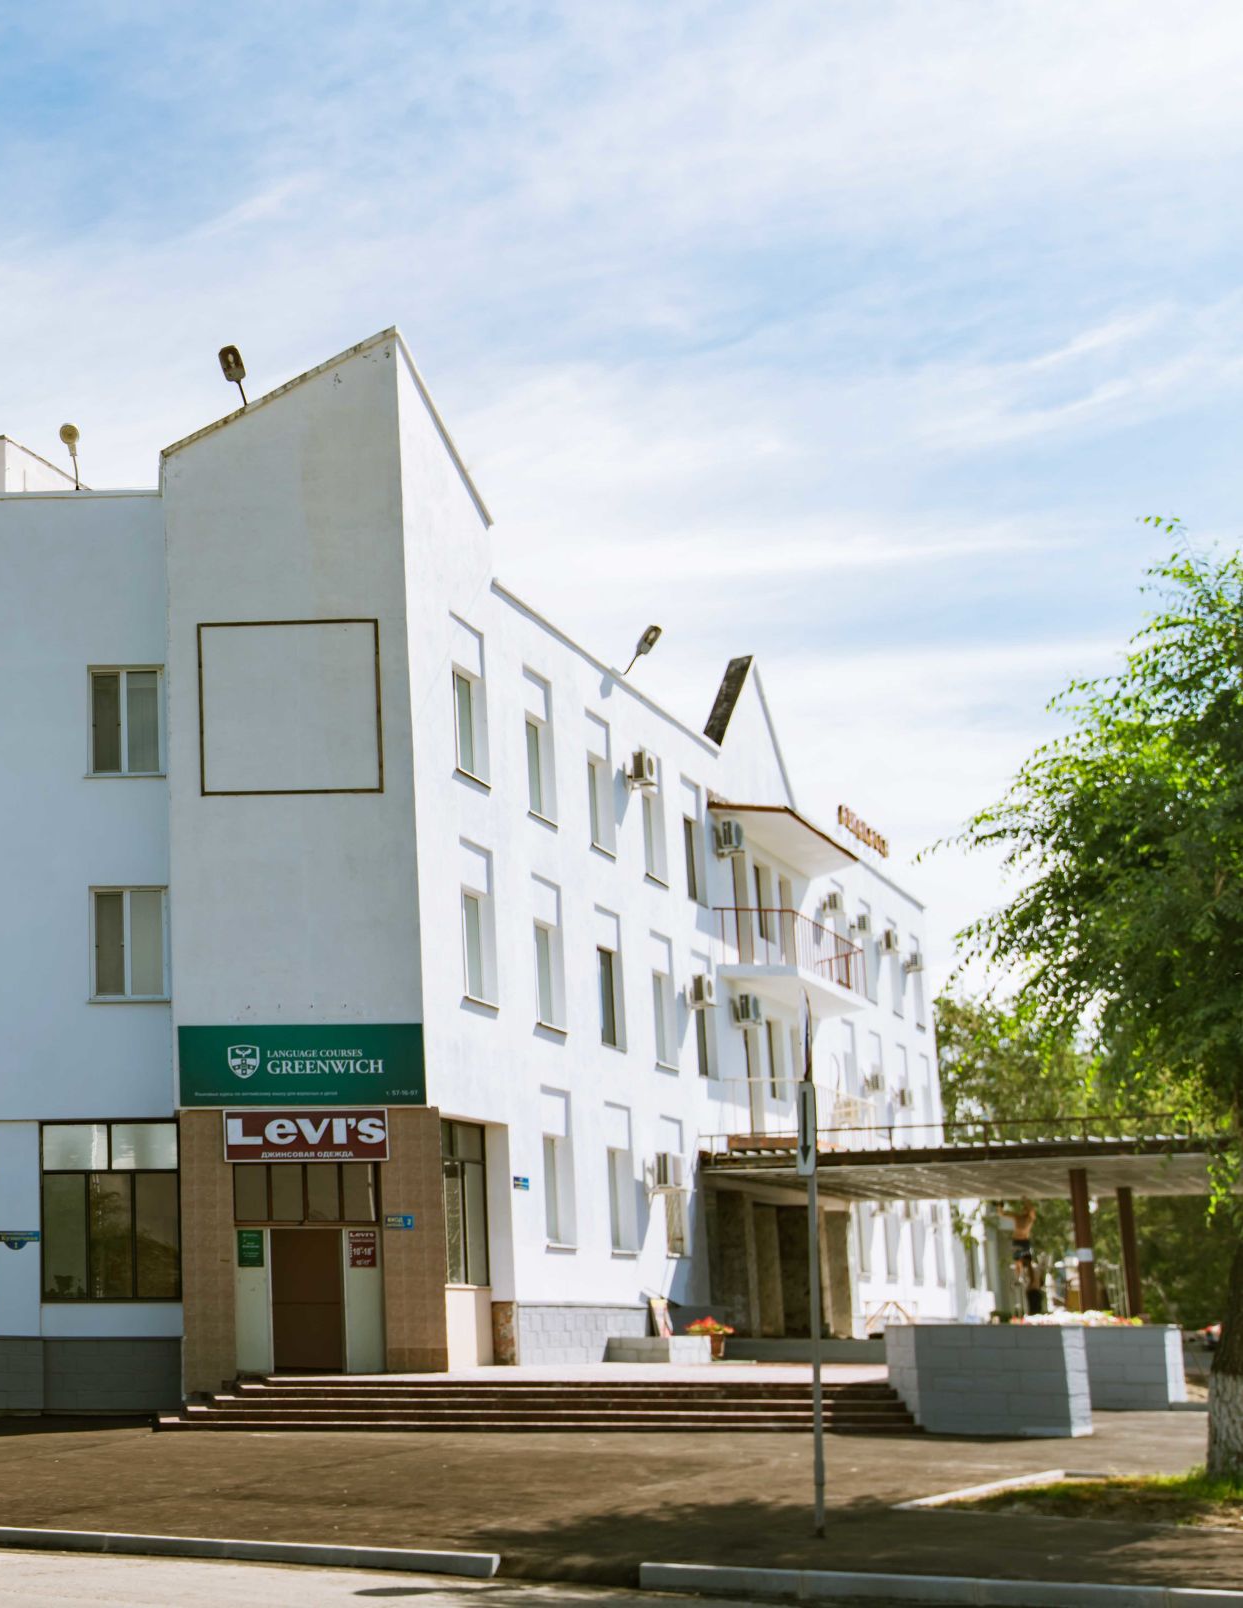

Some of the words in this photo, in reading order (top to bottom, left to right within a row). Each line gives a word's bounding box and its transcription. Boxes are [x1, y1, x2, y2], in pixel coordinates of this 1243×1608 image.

[267, 1049, 317, 1058] LANGUAGE
[319, 1049, 363, 1057] COURSES
[266, 1059, 385, 1075] GREENWICH
[317, 1150, 354, 1158] ОДЕЖДА
